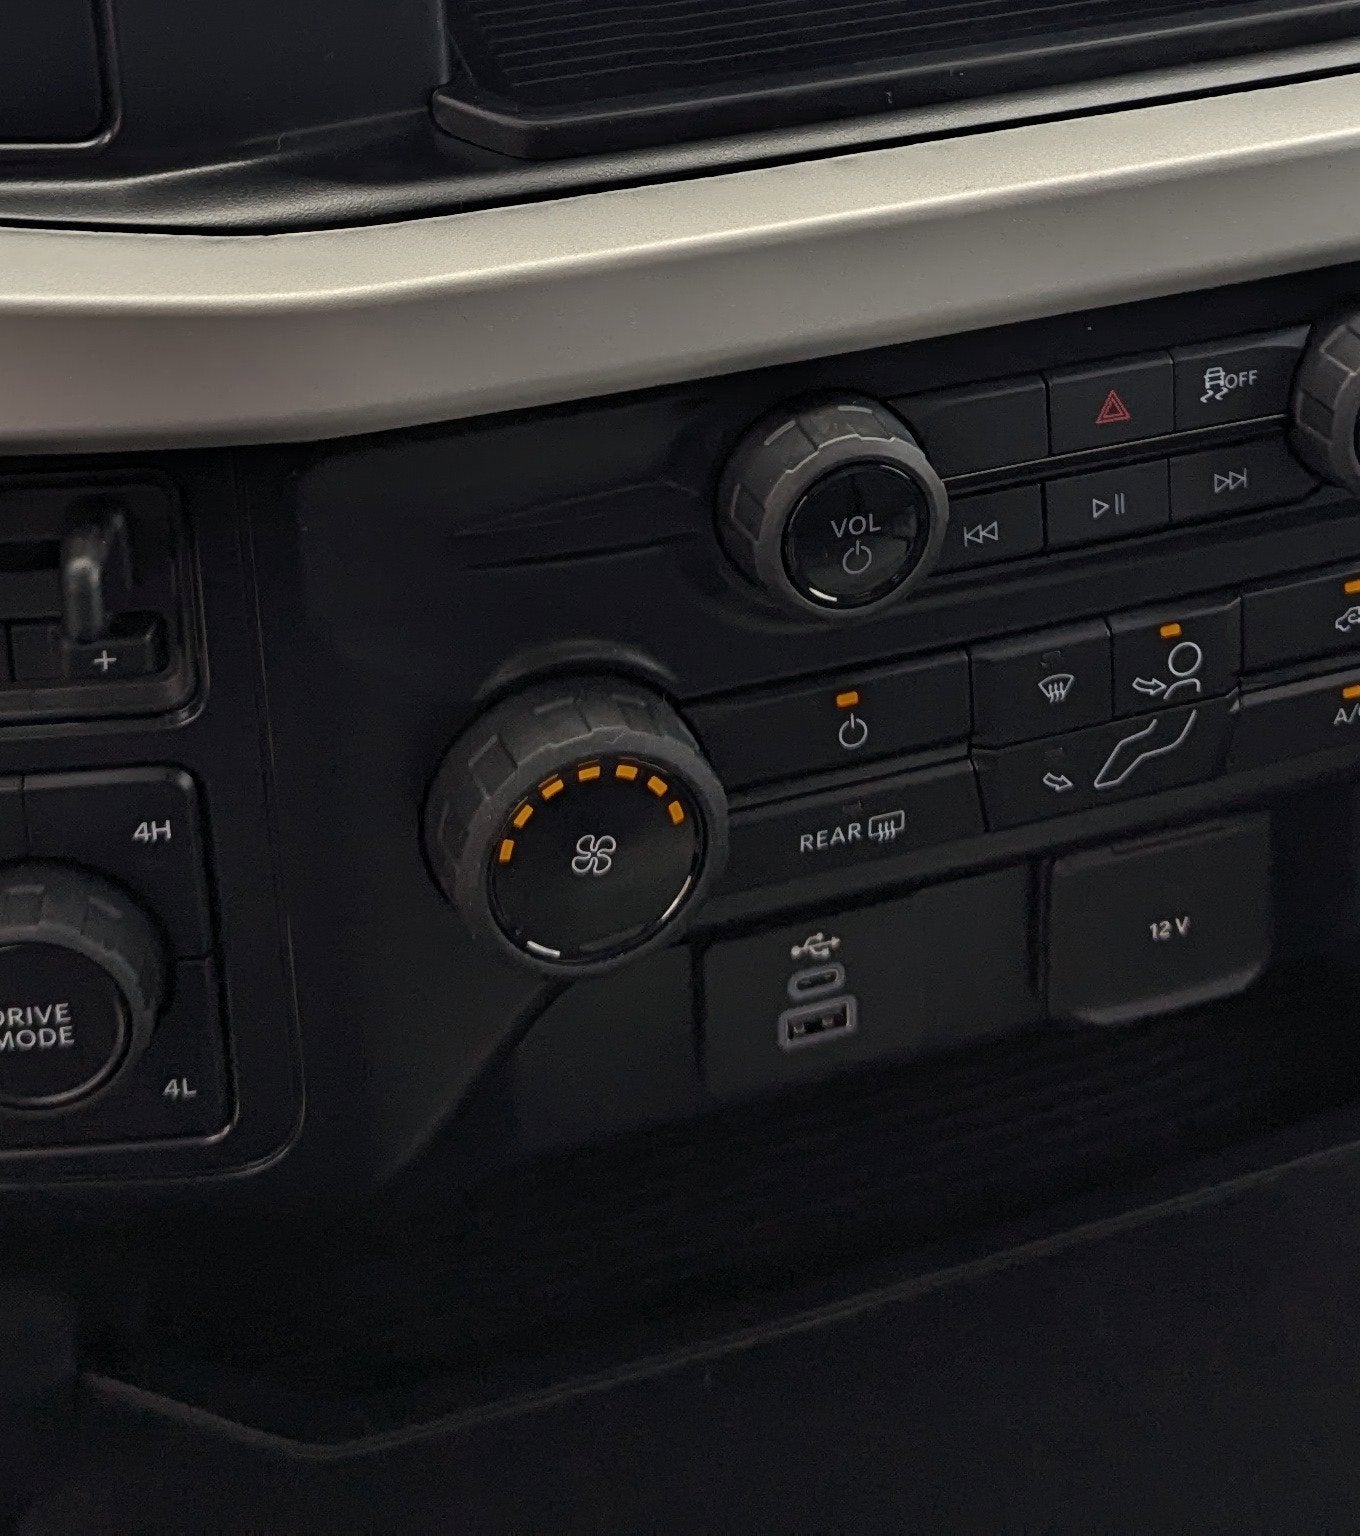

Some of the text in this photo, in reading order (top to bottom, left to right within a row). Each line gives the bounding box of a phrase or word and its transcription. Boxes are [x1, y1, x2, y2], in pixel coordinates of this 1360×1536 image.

[1224, 369, 1258, 389] OFF
[830, 513, 881, 538] VOL
[133, 819, 172, 843] 4H
[800, 822, 862, 853] REAR
[162, 1077, 198, 1098] 4L
